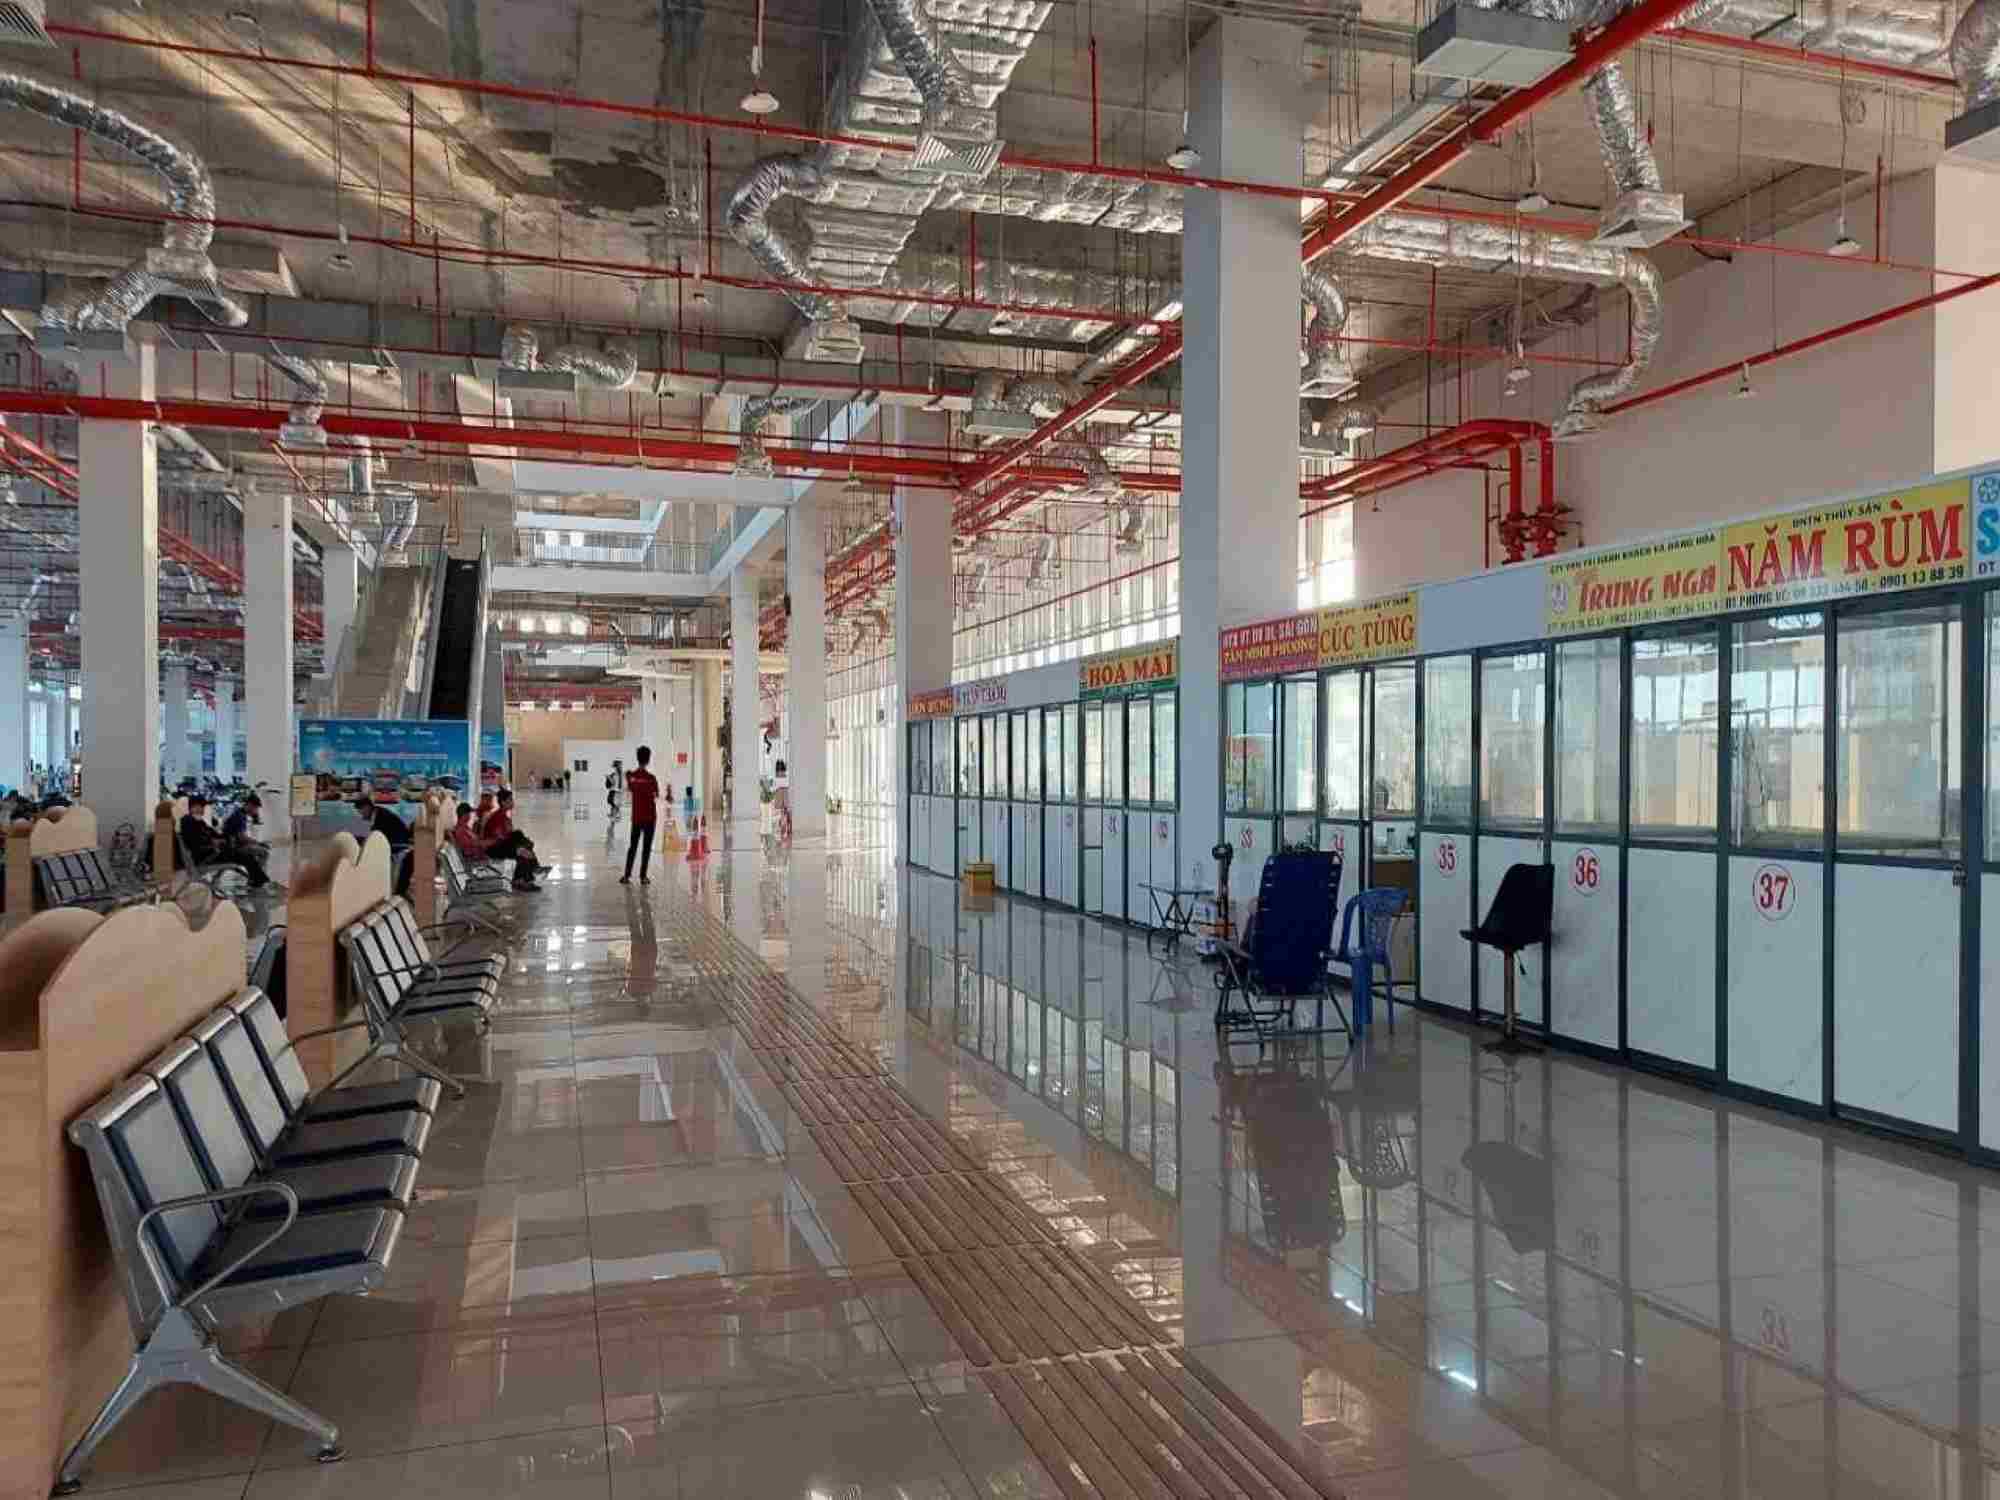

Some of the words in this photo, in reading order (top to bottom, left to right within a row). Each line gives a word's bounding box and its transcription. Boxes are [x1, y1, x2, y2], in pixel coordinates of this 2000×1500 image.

[1728, 523, 1826, 592] NĂM
[1844, 499, 1964, 574] RÙM
[1663, 564, 1716, 599] NGA
[1320, 620, 1354, 653] CÚC
[1360, 612, 1415, 648] TÙNG
[1088, 662, 1128, 689] HOA
[1438, 843, 1456, 870] 35
[1575, 854, 1599, 888] 36
[1760, 873, 1789, 911] 37
